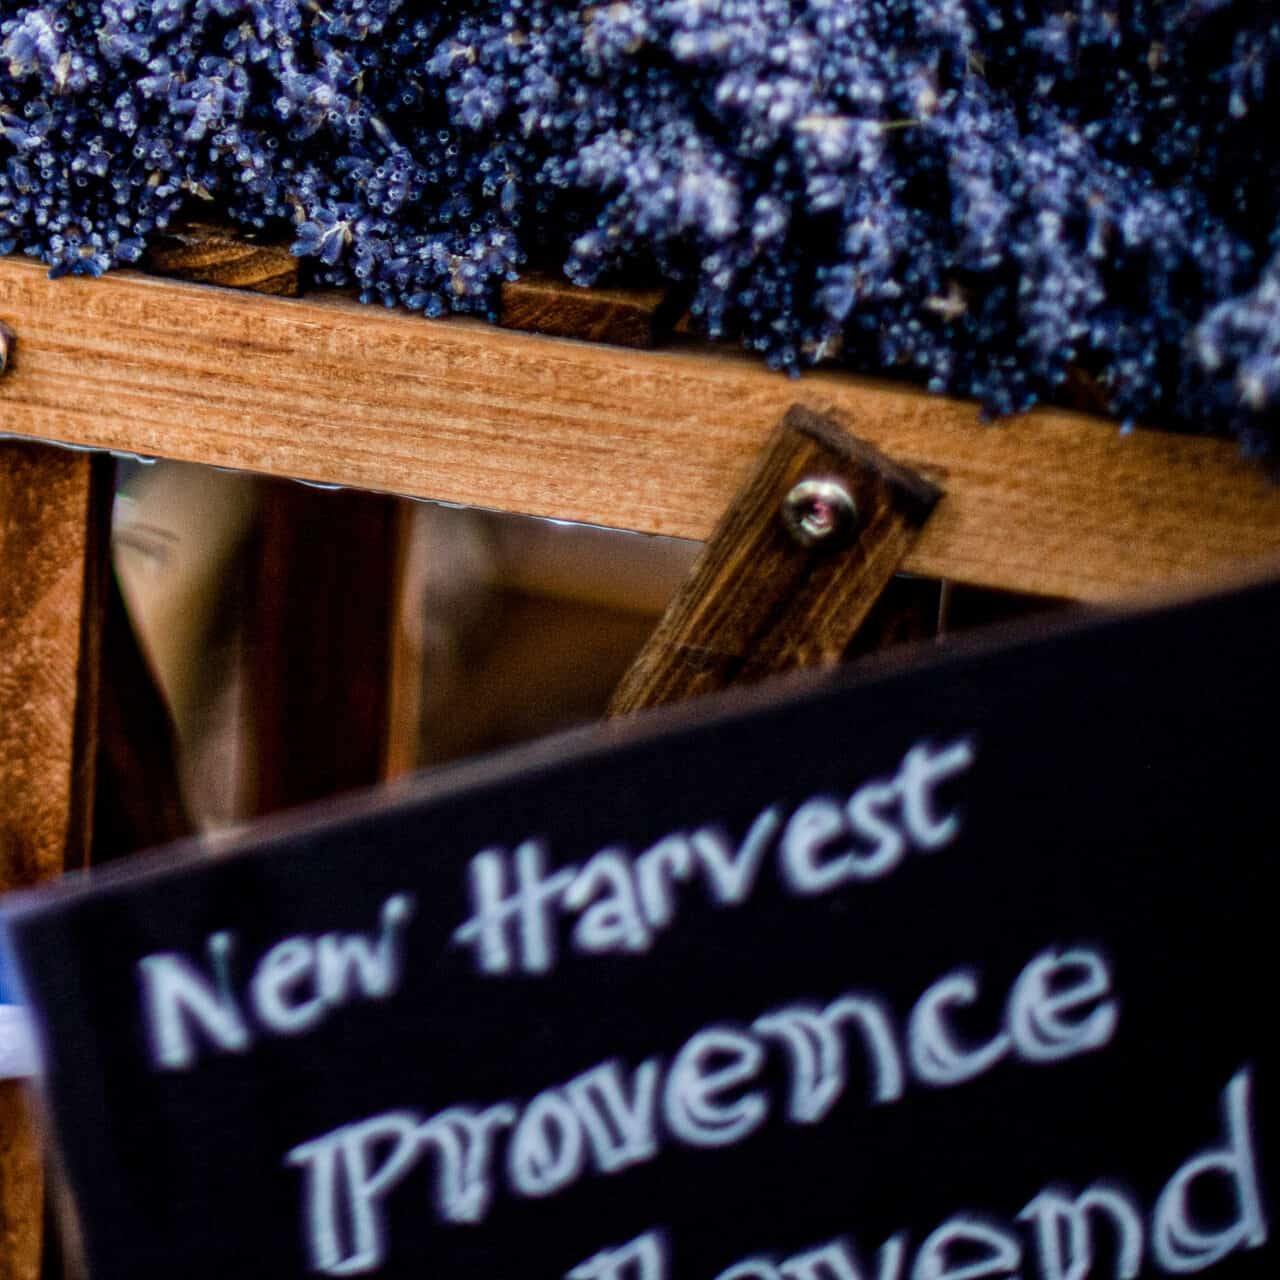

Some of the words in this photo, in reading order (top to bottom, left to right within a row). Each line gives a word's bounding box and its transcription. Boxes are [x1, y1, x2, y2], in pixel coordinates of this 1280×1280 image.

[138, 894, 410, 1070] New
[458, 738, 975, 974] Harvest
[287, 946, 1118, 1277] Provence
[563, 1067, 1269, 1280] end
